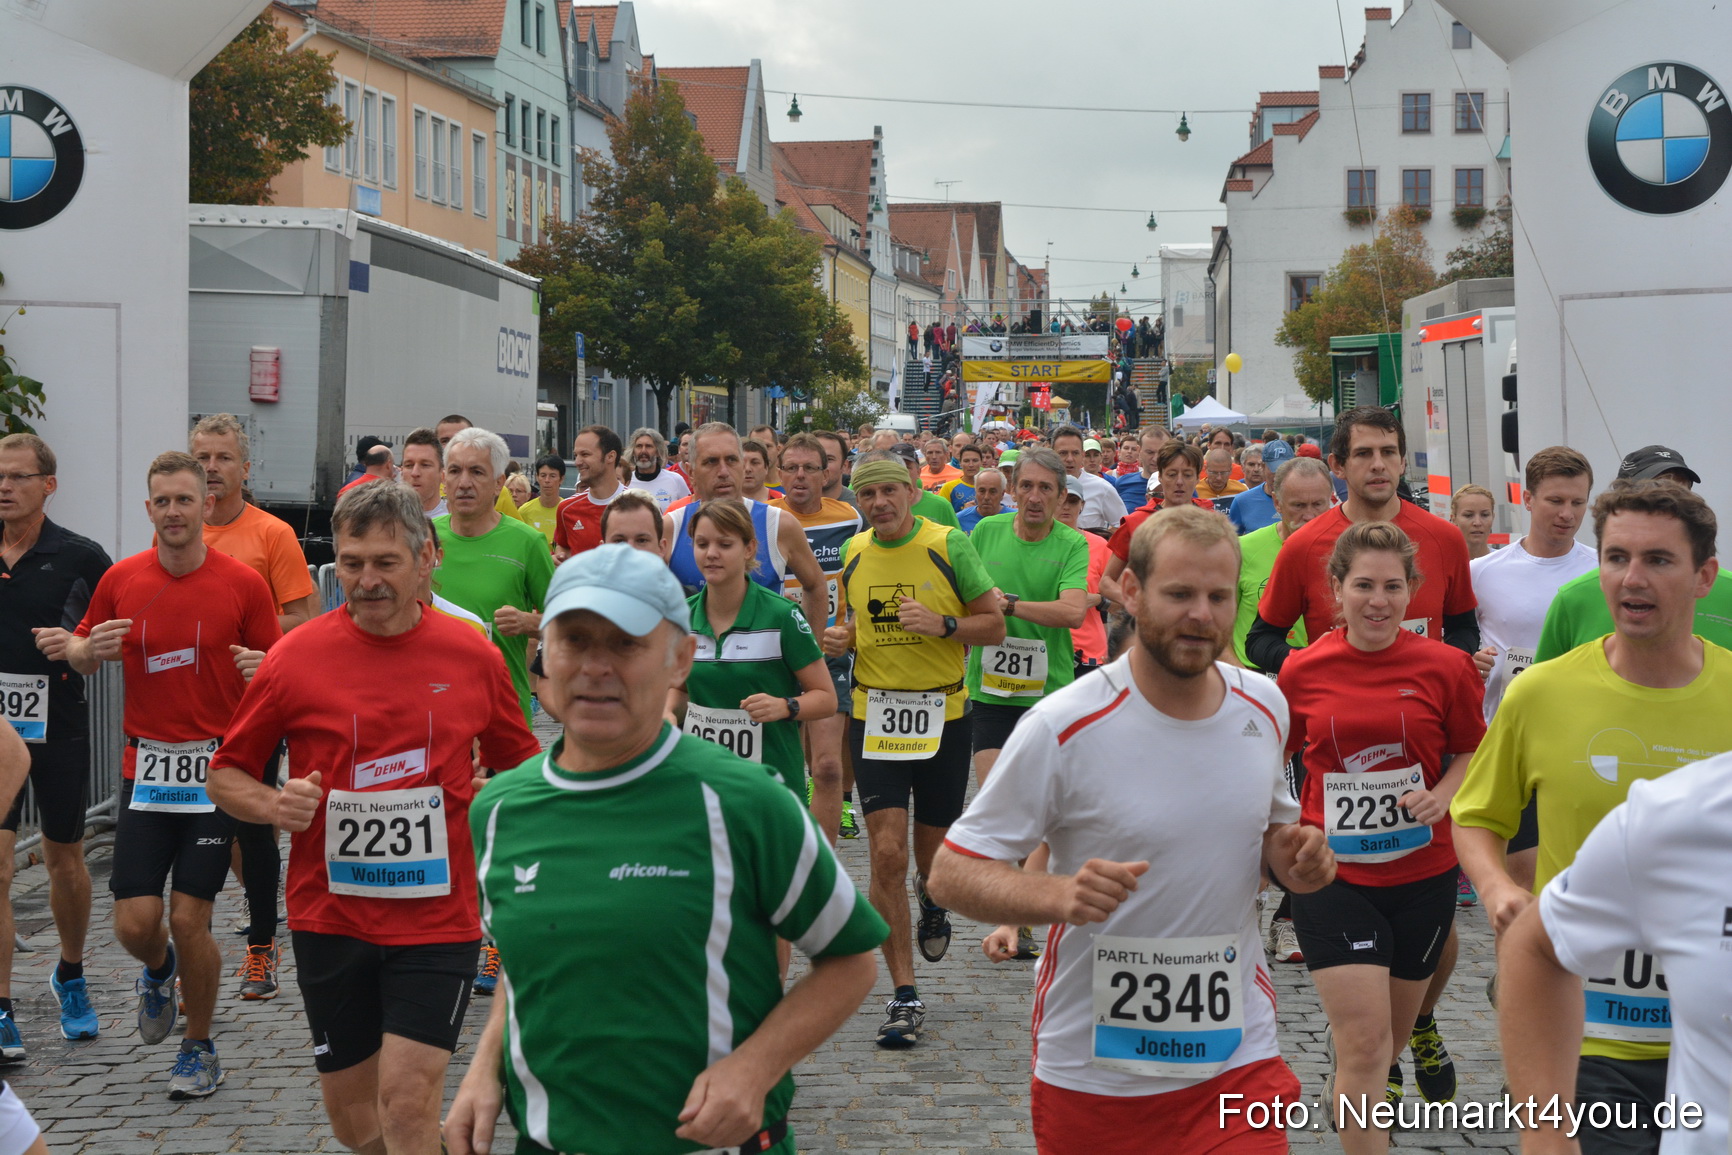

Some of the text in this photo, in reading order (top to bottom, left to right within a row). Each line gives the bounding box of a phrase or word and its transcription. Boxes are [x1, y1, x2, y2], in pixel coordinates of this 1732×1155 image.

[1600, 66, 1725, 118] BMW
[0, 89, 73, 137] MW
[497, 326, 532, 378] BOCK
[1010, 364, 1062, 377] START
[1006, 643, 1038, 652] Neumarkt
[160, 654, 182, 666] DEHN
[994, 650, 1033, 677] 281
[1507, 653, 1534, 665] PARTL
[997, 679, 1026, 692] Jürgen
[869, 696, 894, 704] PARTL
[705, 715, 747, 726] Neumarkt
[881, 707, 929, 735] 300
[877, 739, 928, 751] Alexander
[1361, 748, 1387, 766] DEHN
[143, 753, 210, 784] 2180
[374, 760, 406, 777] DEHN
[1326, 778, 1408, 791] PARTL Neumarkt
[150, 788, 198, 802] Christian
[329, 800, 425, 813] PARTL Neumarkt
[338, 814, 433, 857] 2231
[1360, 836, 1400, 852] Sarah
[352, 866, 425, 886] Wolfgang
[609, 862, 668, 881] africon
[1097, 949, 1220, 966] PARTL Neumarkt
[1110, 970, 1231, 1023] 2346
[1135, 1036, 1206, 1058] Jochen
